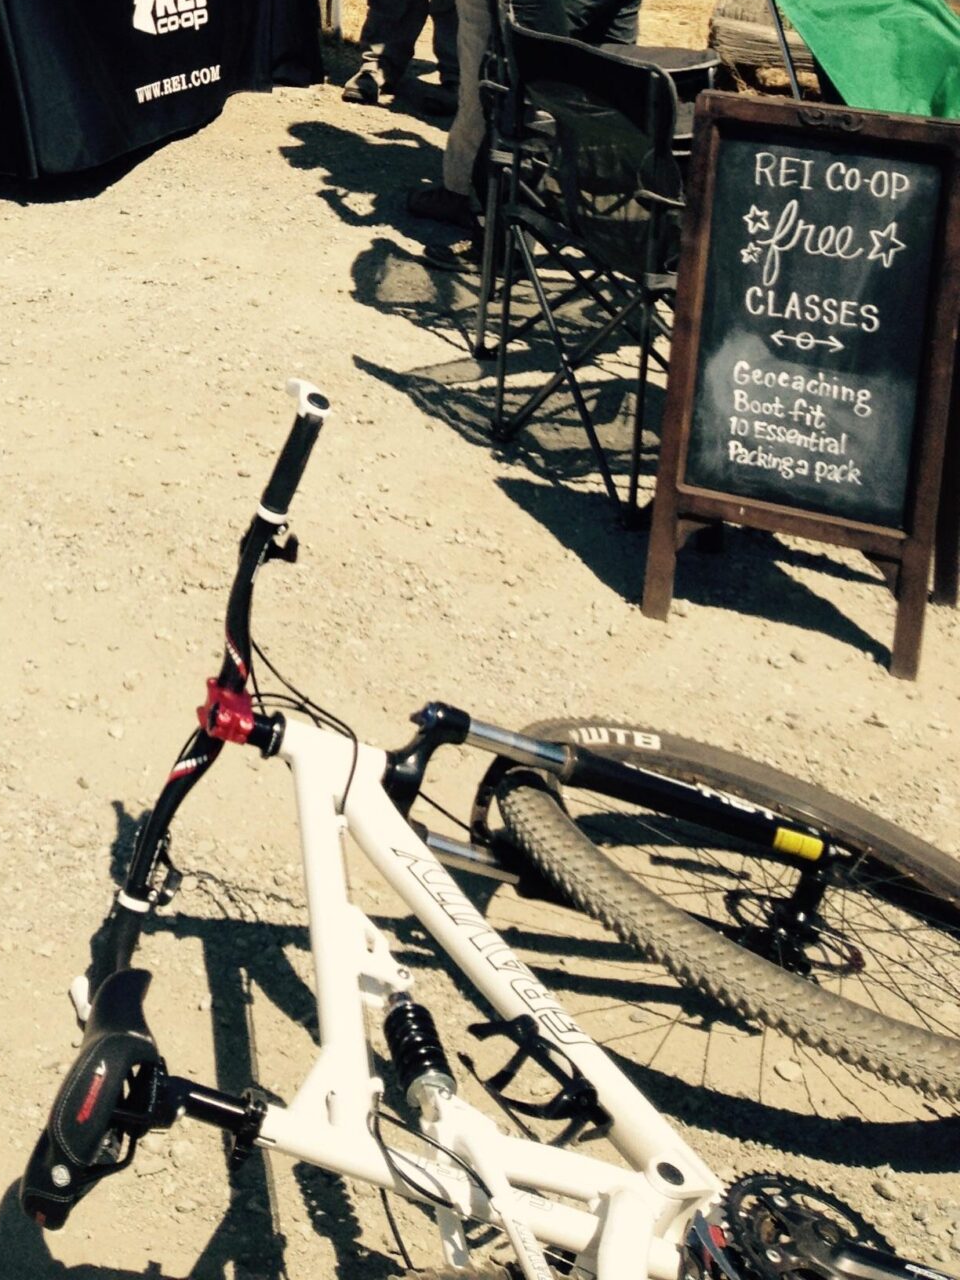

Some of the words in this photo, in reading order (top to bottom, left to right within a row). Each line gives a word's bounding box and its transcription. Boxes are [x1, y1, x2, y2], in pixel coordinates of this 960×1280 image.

[134, 64, 221, 104] WWW.REI.COM
[754, 151, 814, 190] REI
[756, 199, 864, 287] free
[745, 285, 880, 333] CLASSES
[733, 360, 872, 417] Geocaching
[733, 389, 785, 419] Boot
[788, 398, 826, 430] fit
[728, 416, 749, 436] 10
[754, 421, 848, 455] Essential
[728, 440, 794, 480] Packing
[795, 459, 809, 476] a
[814, 459, 863, 485] pack
[579, 726, 661, 751] WTB
